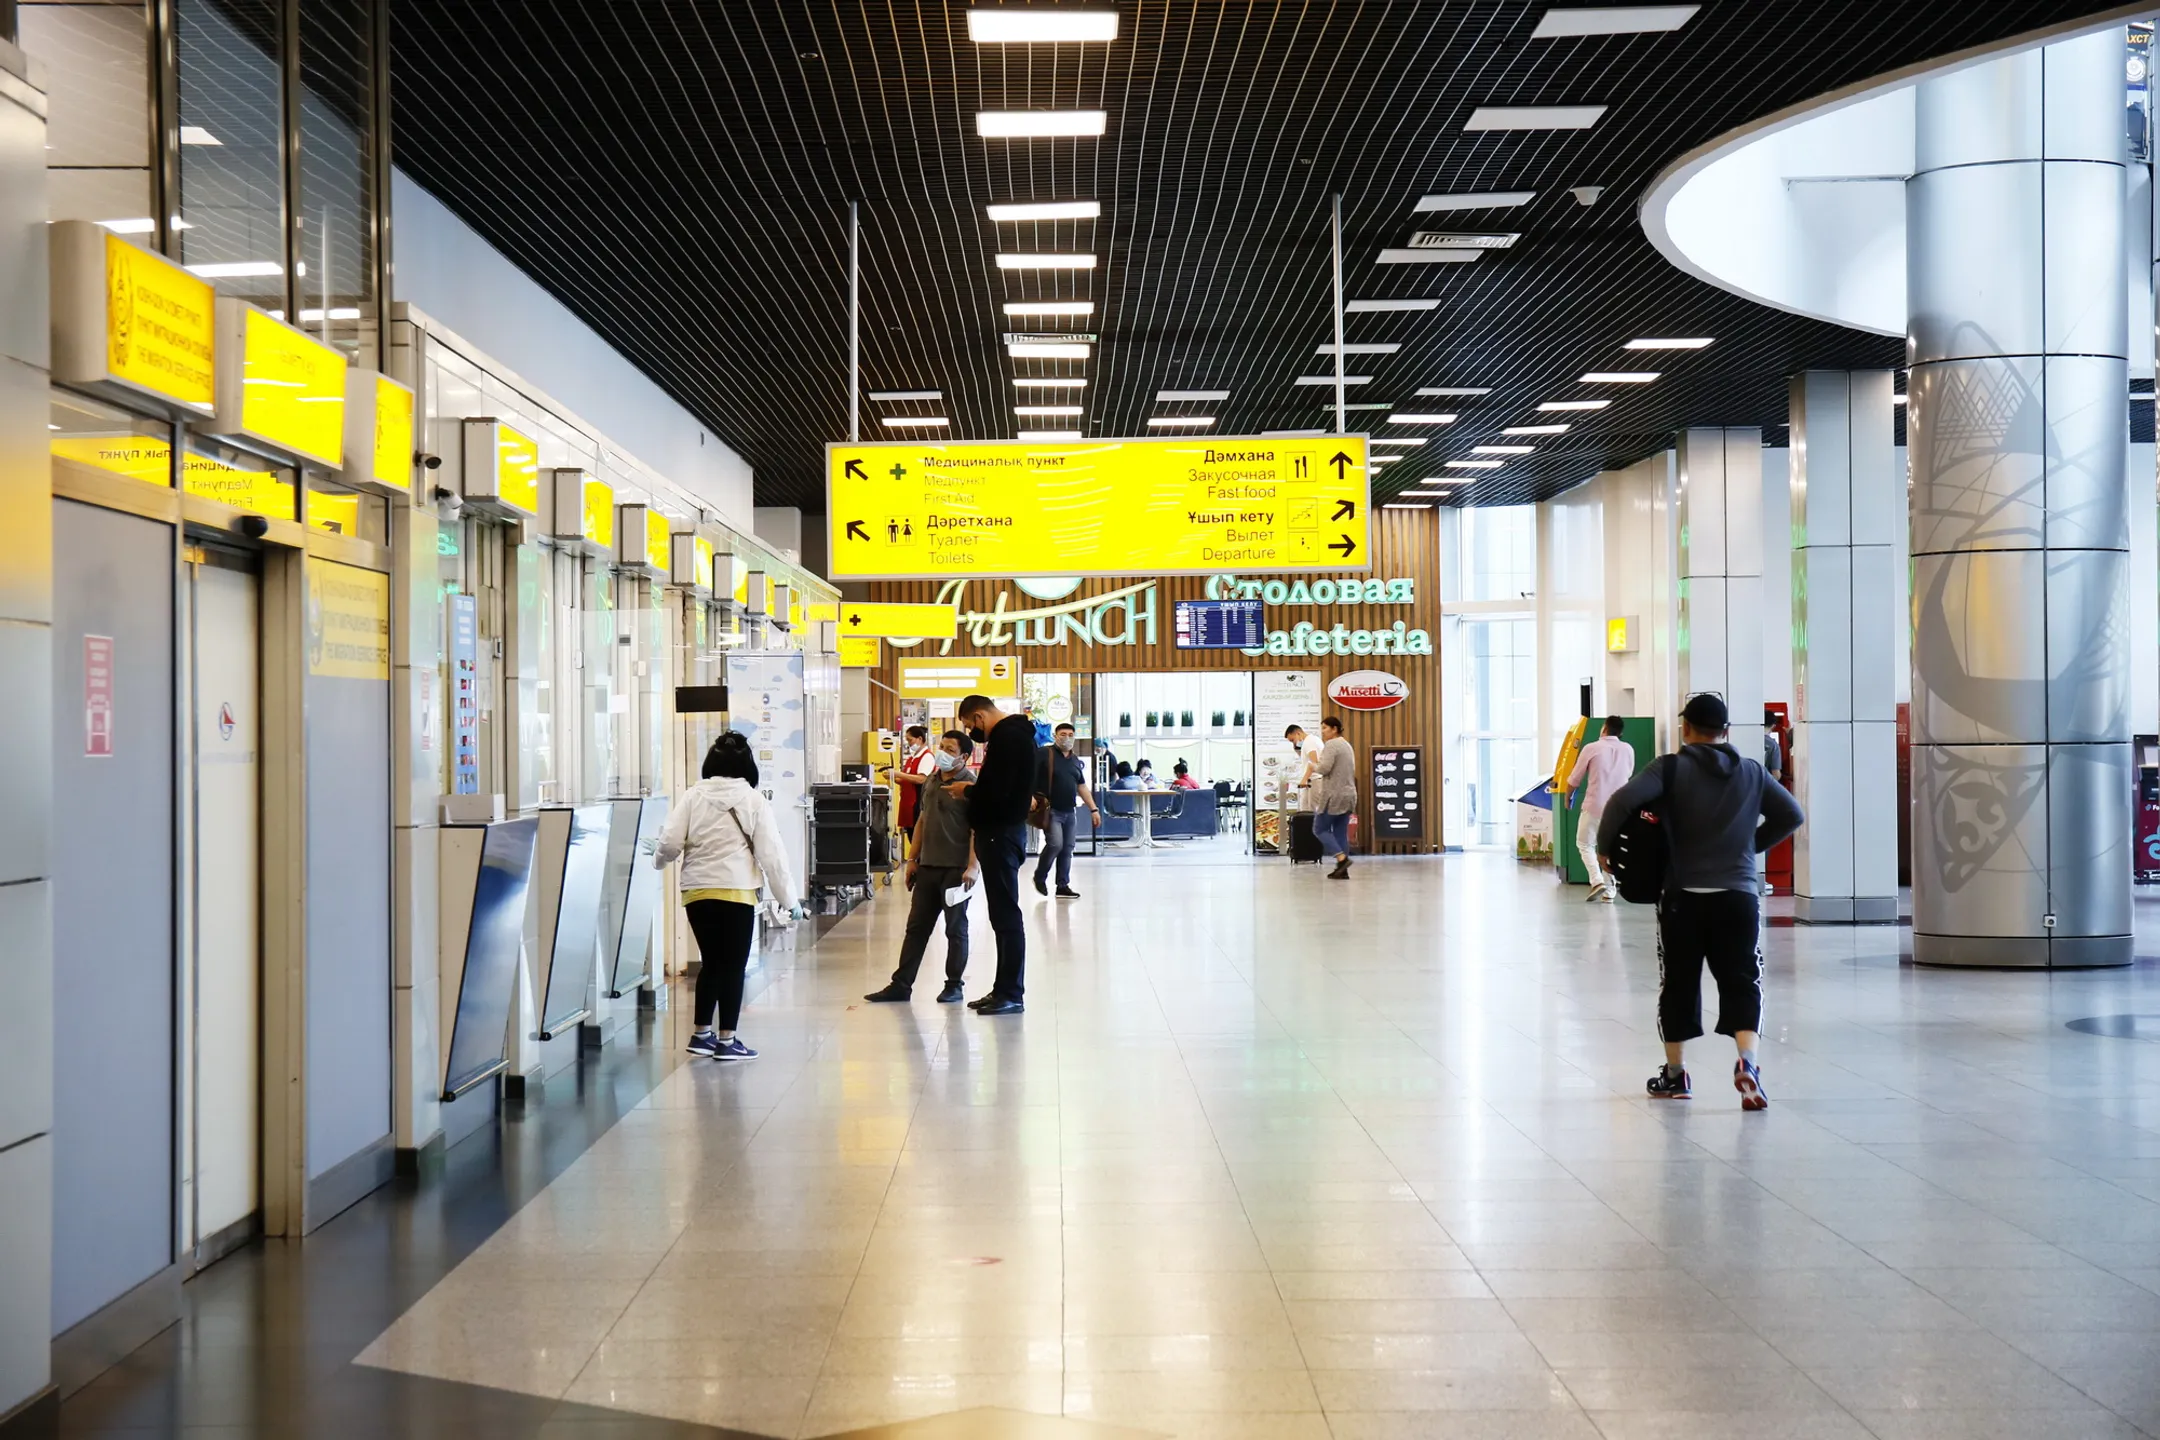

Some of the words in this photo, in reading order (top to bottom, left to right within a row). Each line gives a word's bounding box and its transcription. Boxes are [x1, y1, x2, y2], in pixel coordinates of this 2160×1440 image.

[924, 456, 1023, 469] Медициналық
[1027, 456, 1066, 469] пункт
[1203, 449, 1275, 465] Дәмхана
[924, 475, 987, 487] Медпункт
[1188, 468, 1276, 484] Закусочная
[924, 493, 951, 504] First
[954, 493, 975, 504] Aid
[1207, 485, 1240, 499] Fast
[1244, 485, 1276, 498] food
[926, 514, 1013, 530] Дәретхана
[1188, 511, 1235, 524] Ұшып
[1240, 512, 1274, 525] кету
[928, 533, 979, 549] Туалет
[1226, 529, 1275, 542] Вылет
[928, 551, 975, 565] Toilets
[1203, 547, 1276, 562] Departure
[1205, 574, 1415, 605] Столовая
[1015, 586, 1157, 649] LUNCH
[1338, 684, 1382, 696] Musetti
